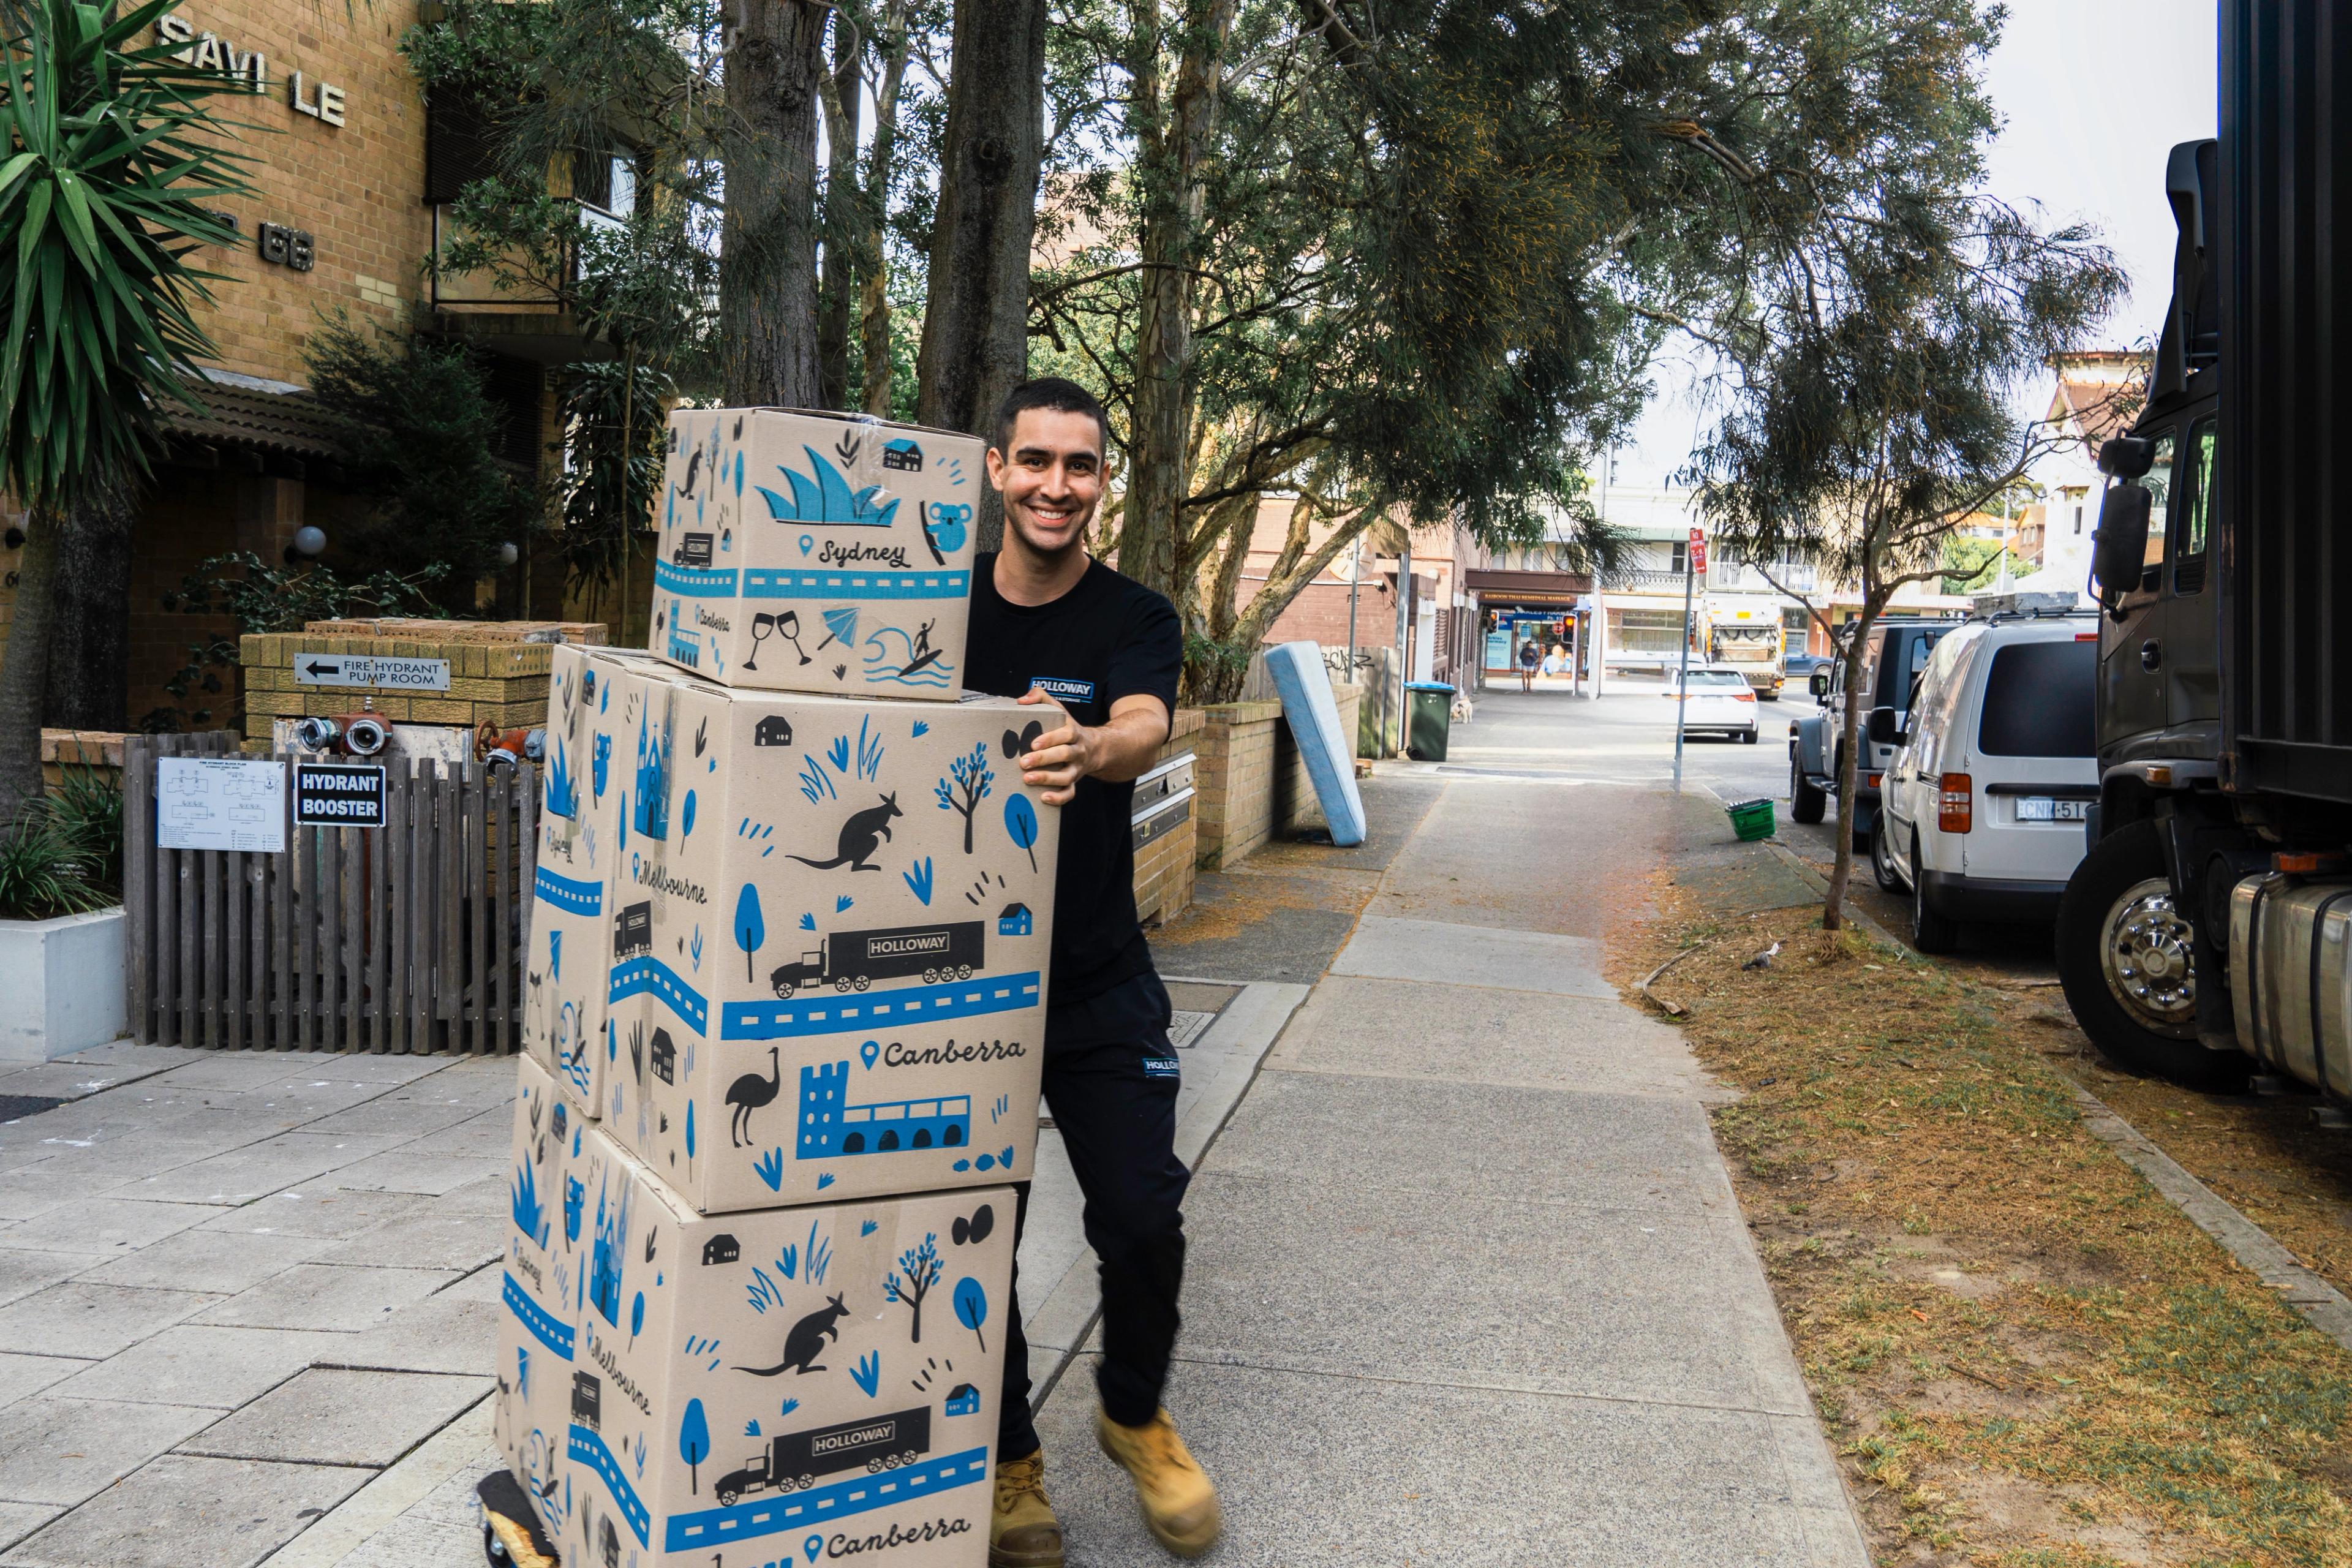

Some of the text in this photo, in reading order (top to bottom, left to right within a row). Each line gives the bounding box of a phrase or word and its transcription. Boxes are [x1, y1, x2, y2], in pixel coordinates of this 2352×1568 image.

[260, 222, 314, 271] 66
[818, 540, 911, 568] Sydney
[699, 609, 730, 633] Canberra
[345, 661, 440, 675] FIRE HYDRANT
[349, 672, 435, 684] PUMP ROOM
[1031, 680, 1091, 695] HOLLOWAY
[302, 774, 379, 791] HYDRANT
[303, 799, 377, 816] BOOSTER
[639, 860, 707, 904] Melbourne
[870, 936, 946, 954] HOLLOWAY
[884, 1039, 1026, 1067] Canberra
[591, 1336, 651, 1416] Melbourne
[815, 1425, 892, 1451] HOLLOWAY
[828, 1517, 971, 1558] Canberra
